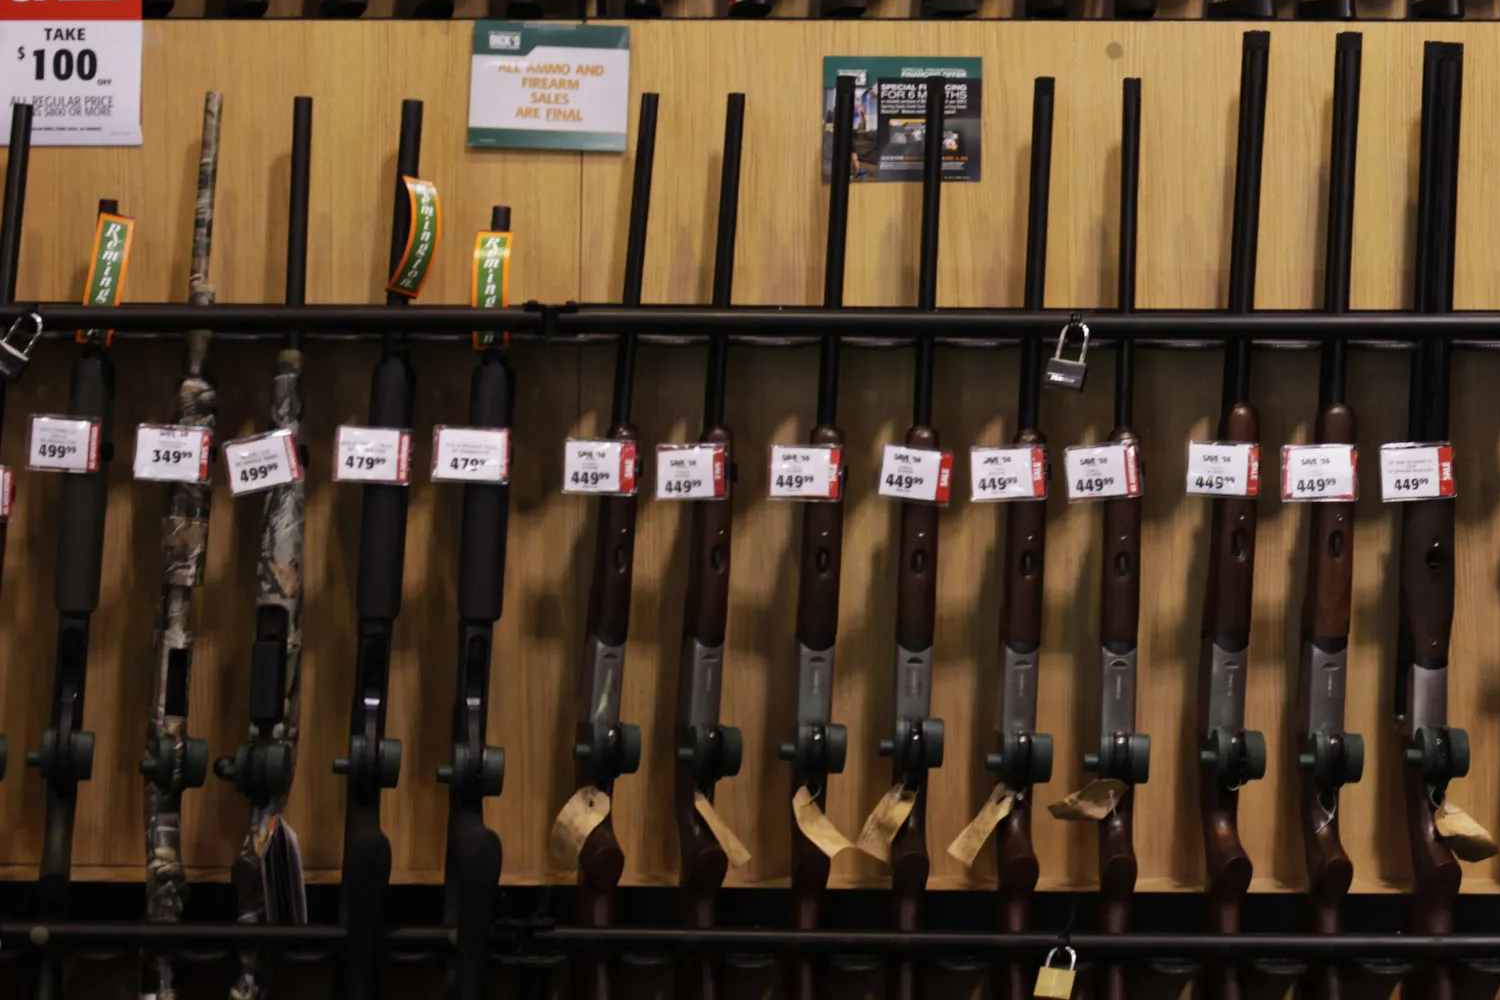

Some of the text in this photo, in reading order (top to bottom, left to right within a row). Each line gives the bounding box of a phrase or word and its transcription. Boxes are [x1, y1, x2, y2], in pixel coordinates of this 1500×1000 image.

[44, 27, 86, 41] TAKE
[526, 64, 570, 75] AMMO
[576, 64, 605, 76] AND
[522, 77, 580, 90] FIREARM
[530, 92, 569, 105] SALES
[880, 91, 905, 99] FOR
[32, 96, 81, 108] REGULAR
[84, 96, 114, 108] PRICE
[515, 107, 583, 122] ARE FINAL
[624, 458, 634, 478] SALE
[1441, 462, 1451, 481] SALE
[940, 468, 949, 487] SALE
